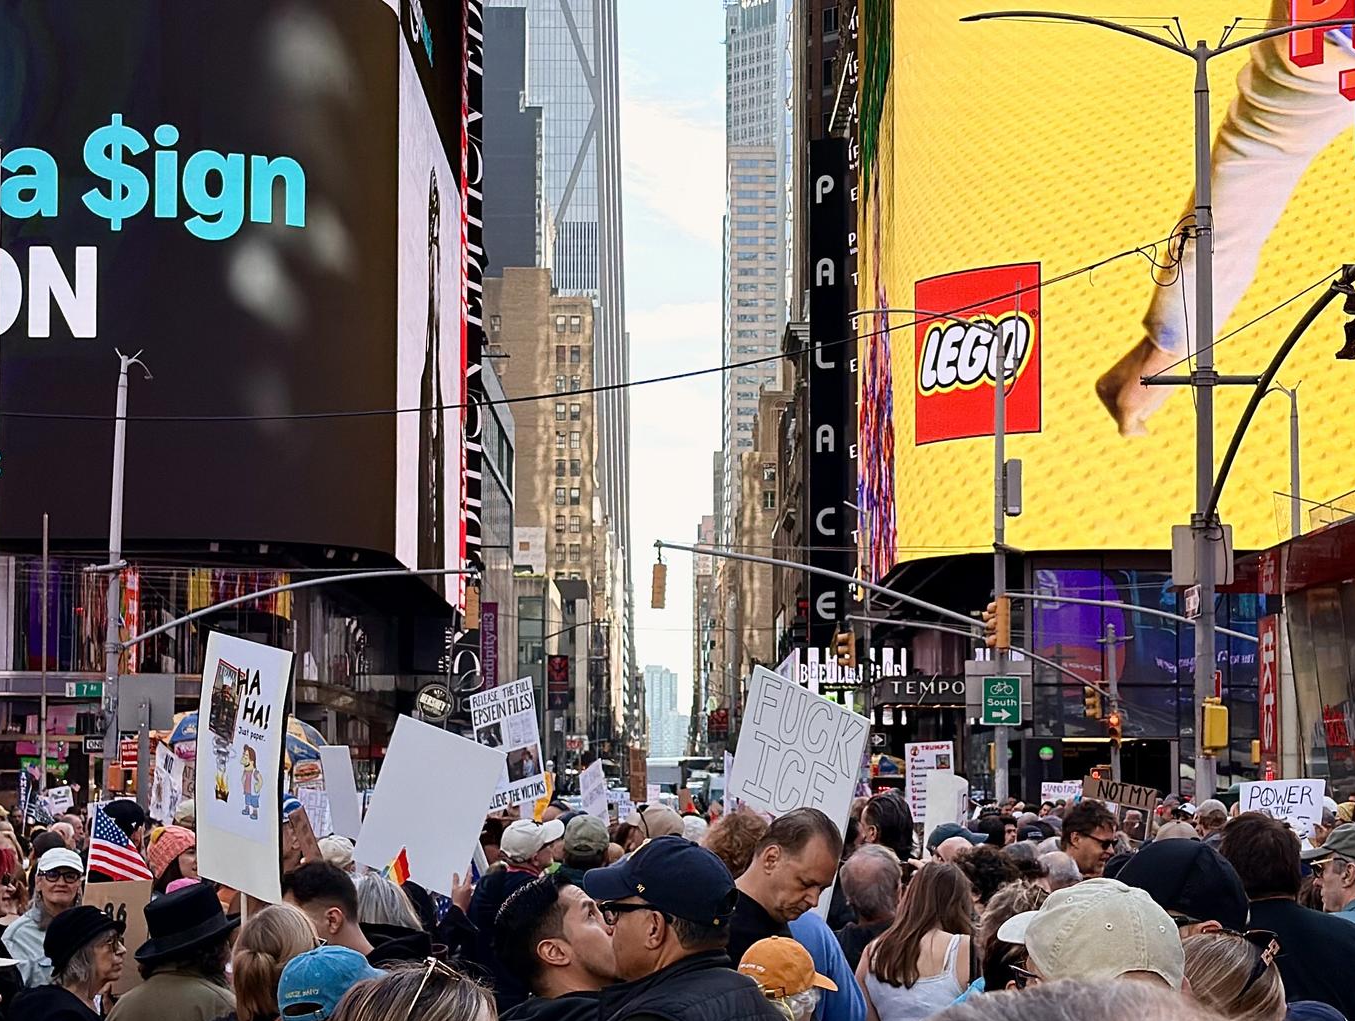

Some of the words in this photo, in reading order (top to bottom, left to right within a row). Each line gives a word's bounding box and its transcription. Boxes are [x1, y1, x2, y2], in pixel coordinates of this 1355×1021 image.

[82, 112, 307, 241] $ign
[920, 316, 1030, 391] LEGO
[816, 174, 836, 620] PALACE
[82, 684, 88, 694] 7
[236, 668, 261, 695] HA
[472, 691, 500, 708] RELEASE
[502, 684, 515, 697] THE
[515, 680, 531, 695] FULL
[891, 681, 965, 695] TEMPO
[243, 697, 271, 730] HA!
[473, 702, 507, 727] EPSTEIN
[507, 691, 534, 716] FILES!
[987, 698, 1017, 707] South
[238, 726, 249, 735] Just
[753, 675, 864, 779] FUCK
[742, 731, 837, 812] ICE
[508, 788, 521, 803] THE
[1097, 780, 1129, 801] NOT
[1129, 786, 1154, 806] MY
[1248, 786, 1314, 810] POWER
[1274, 806, 1294, 815] THE
